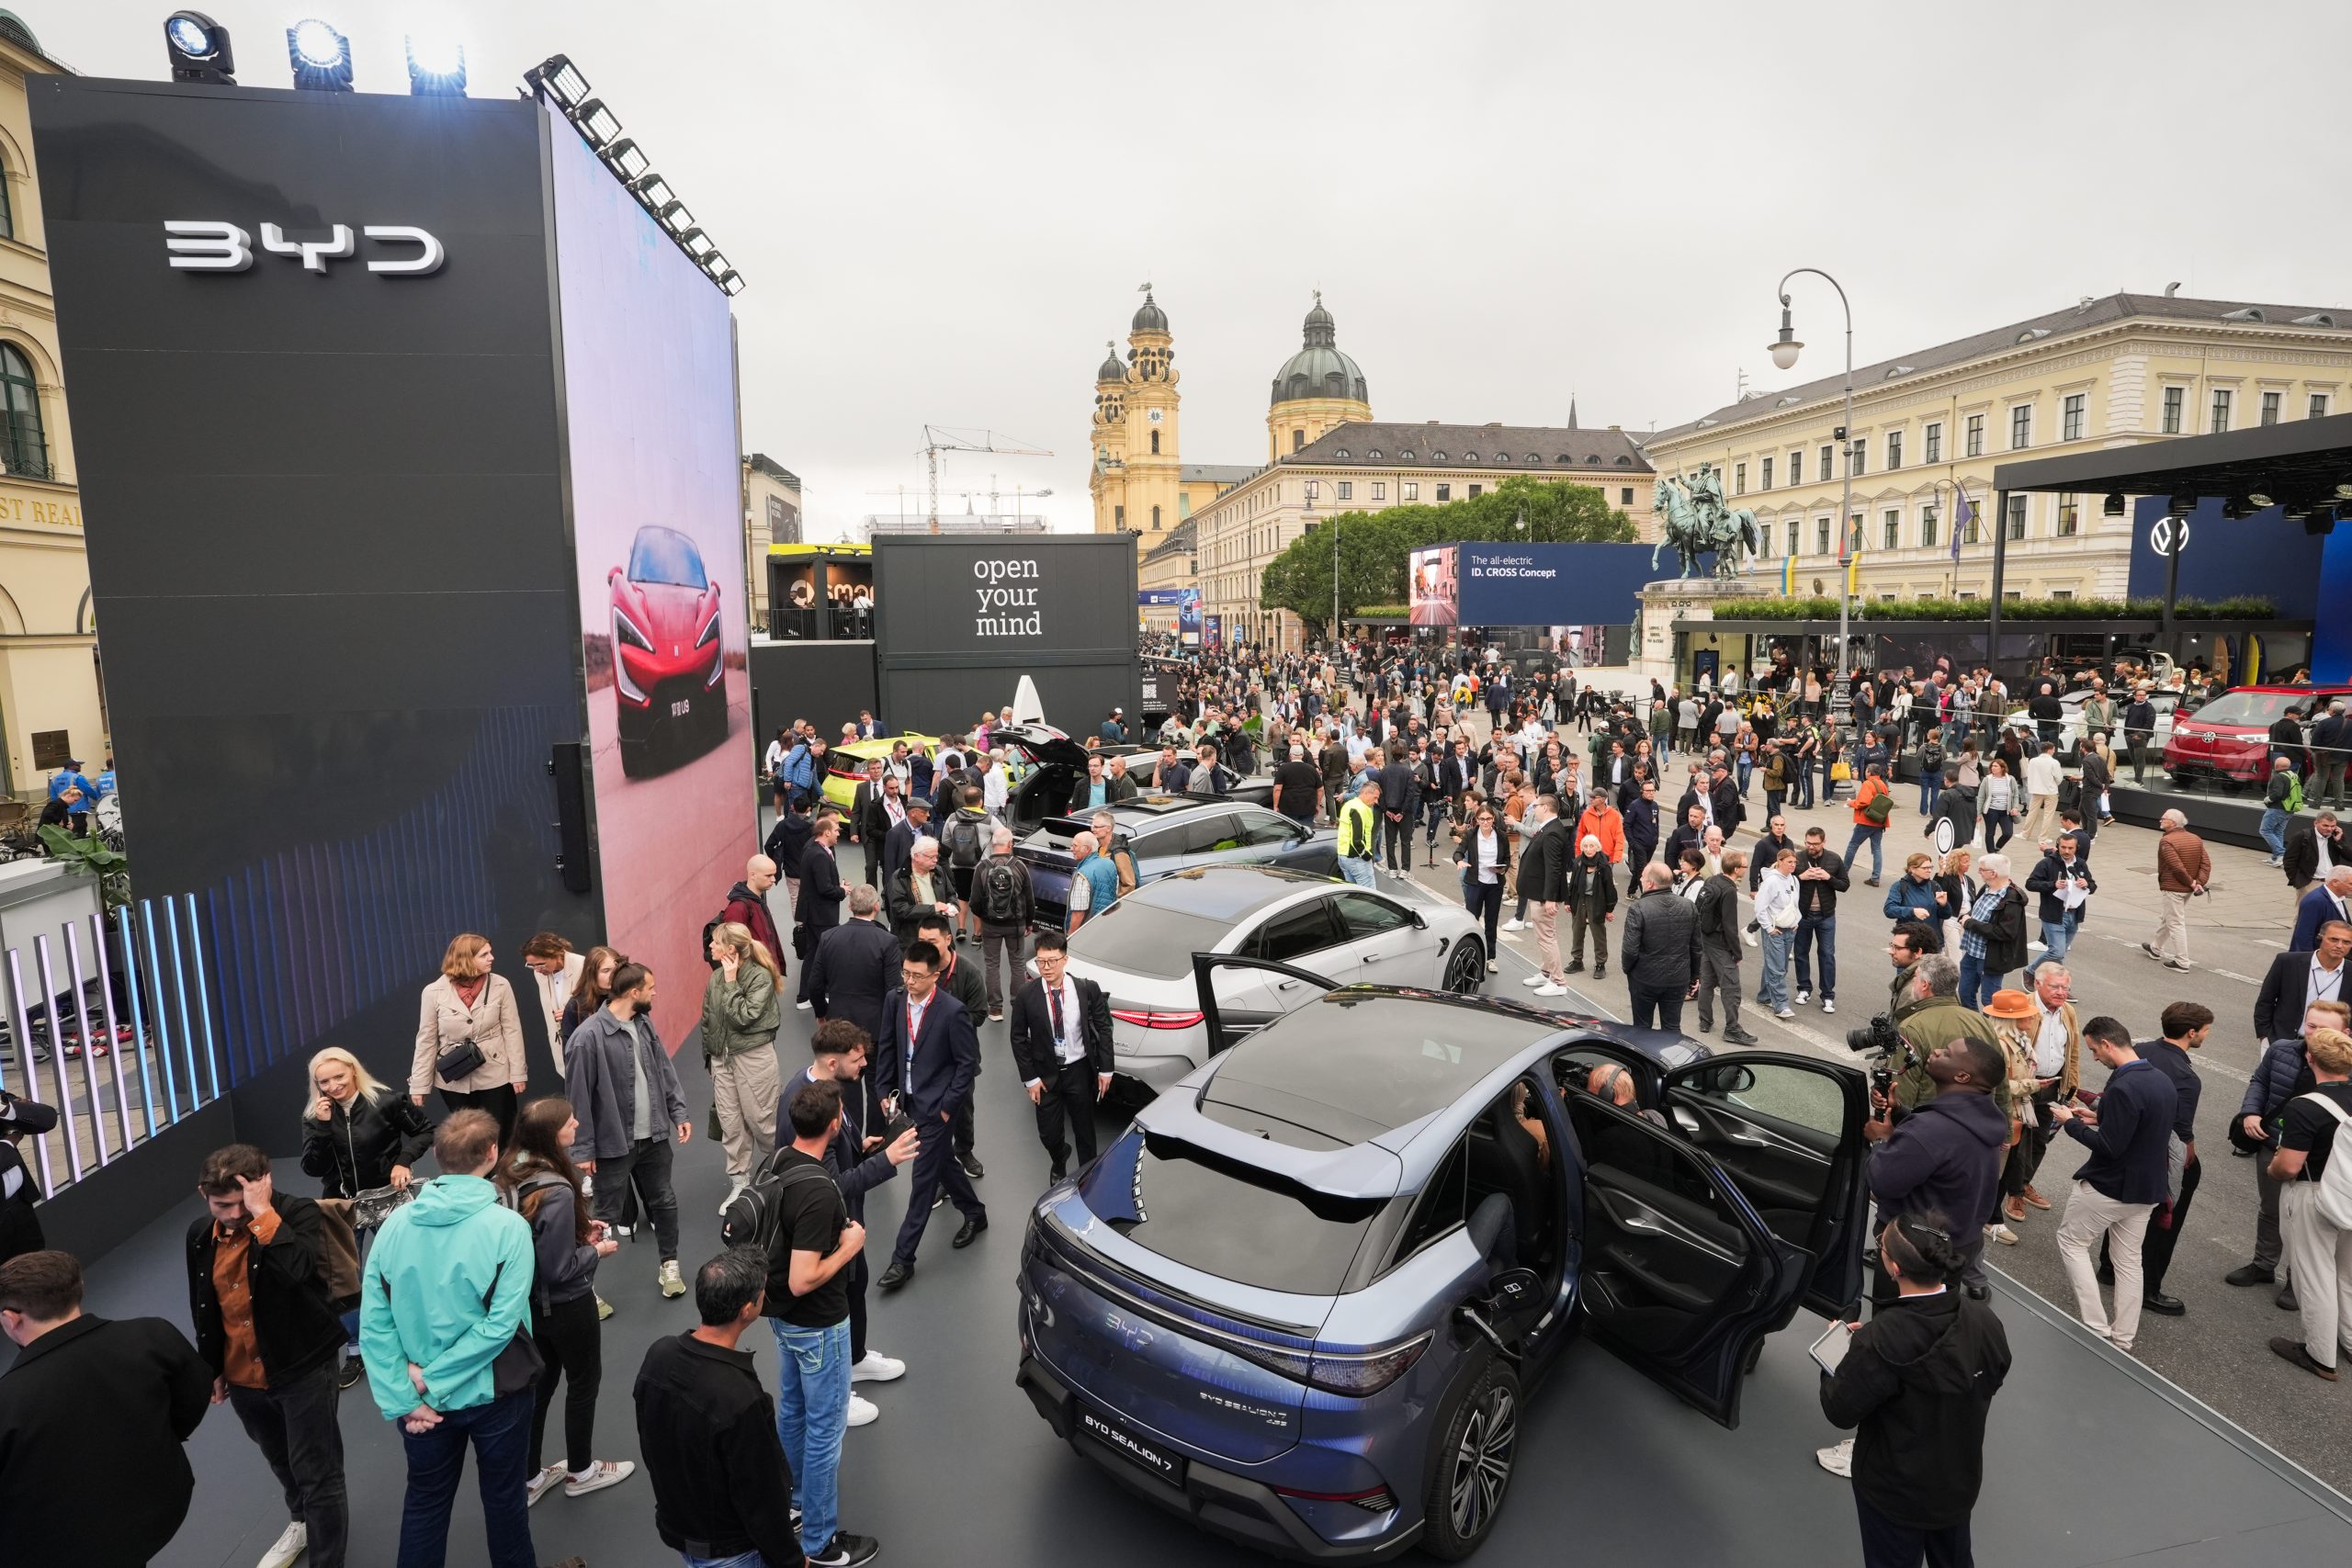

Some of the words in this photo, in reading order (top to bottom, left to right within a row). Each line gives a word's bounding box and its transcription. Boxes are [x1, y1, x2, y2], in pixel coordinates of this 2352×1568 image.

[164, 220, 445, 275] BYD
[974, 559, 1039, 585] open
[1471, 555, 1487, 565] The
[1489, 555, 1533, 565] all-electric
[1471, 568, 1484, 577] ID.
[1486, 568, 1517, 577] CROSS
[1519, 568, 1556, 579] Concept
[976, 588, 1038, 613] your
[976, 611, 1042, 636] mind
[1105, 1312, 1154, 1346] BYD
[1199, 1392, 1223, 1405] BYD
[1224, 1400, 1276, 1417] SEALION
[1085, 1415, 1109, 1434] BYD
[1111, 1430, 1161, 1466] SEALION
[1163, 1461, 1172, 1471] 7
